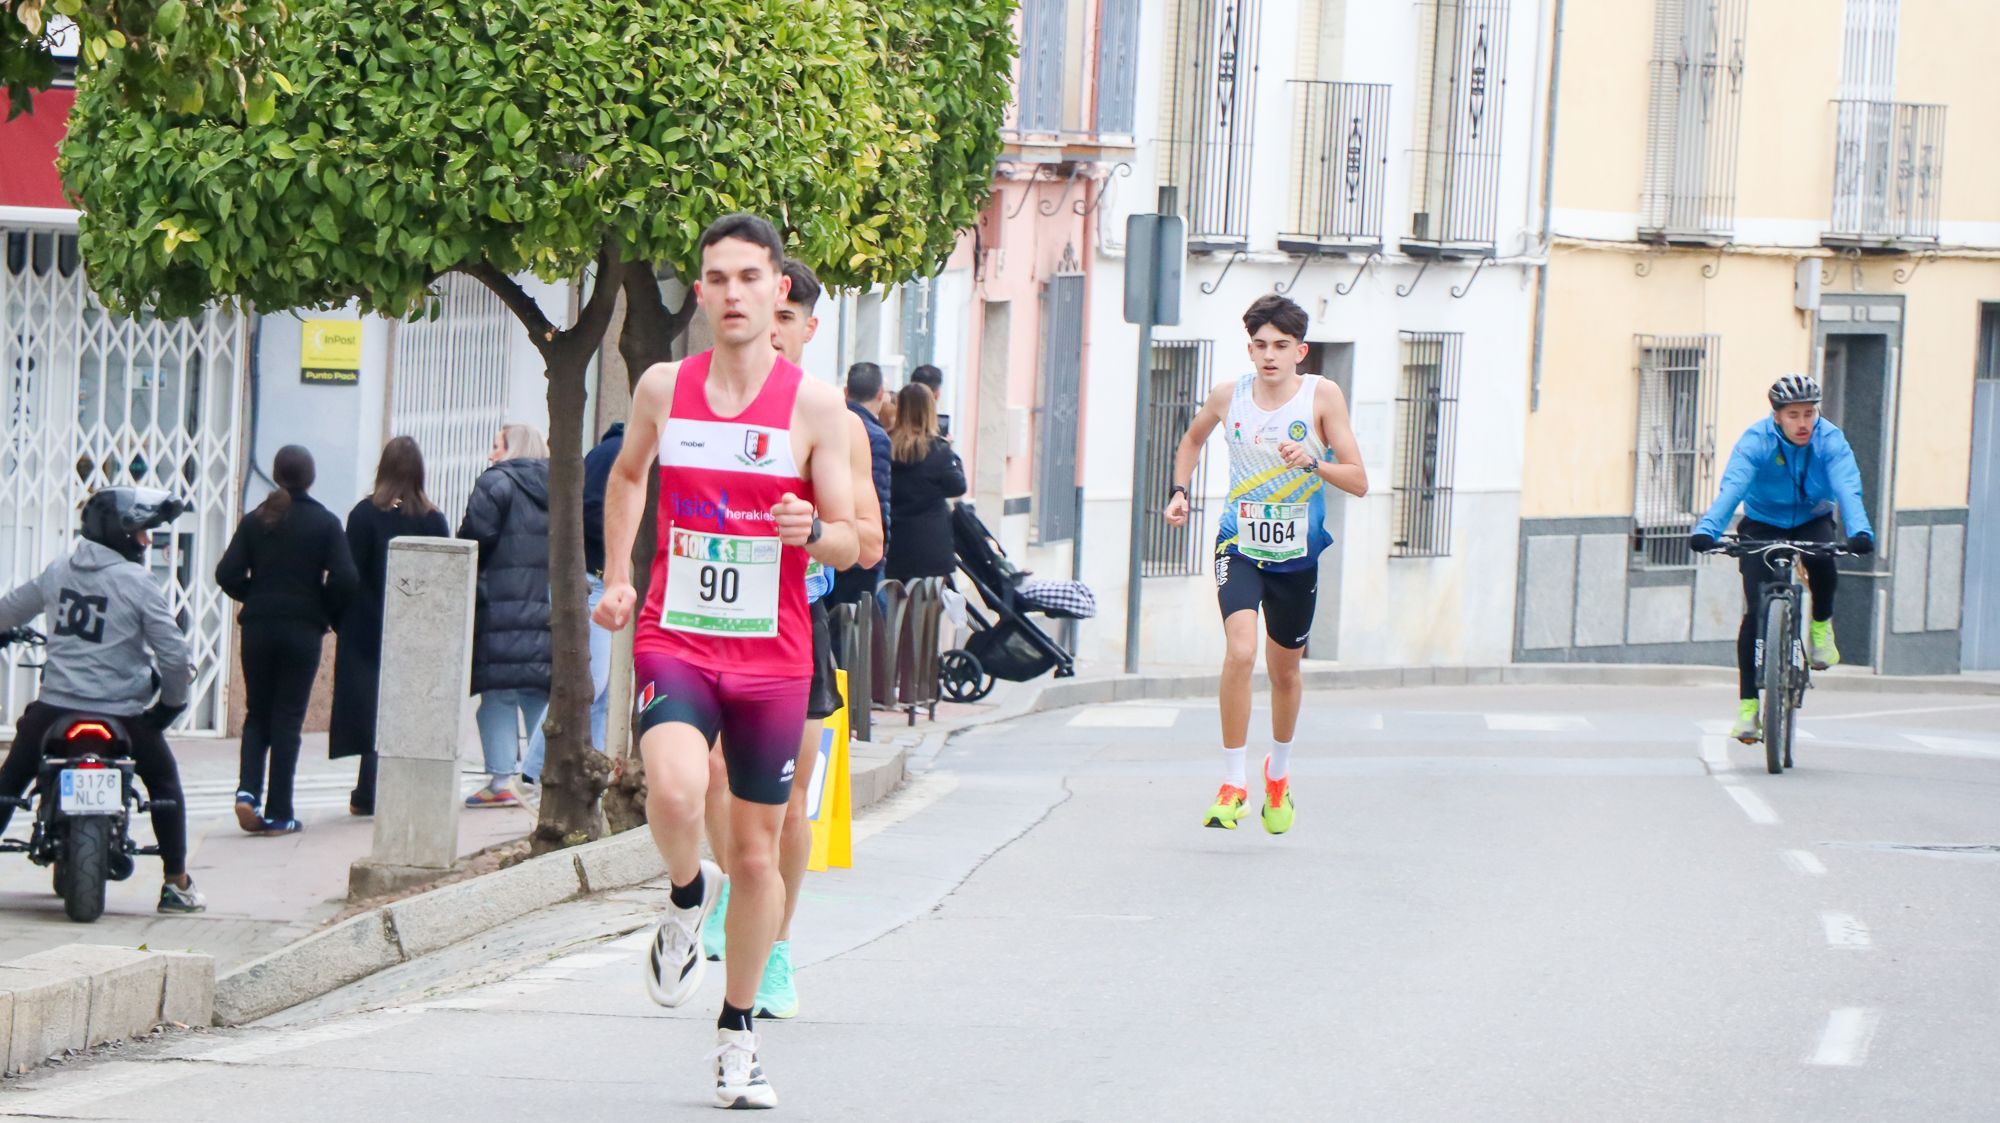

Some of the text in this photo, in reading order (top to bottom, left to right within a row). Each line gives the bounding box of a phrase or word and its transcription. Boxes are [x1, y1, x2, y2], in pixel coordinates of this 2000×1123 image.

[324, 335, 356, 346] InPost
[305, 371, 357, 380] Punto Pack
[680, 440, 705, 448] mobel
[1247, 521, 1296, 544] 1064
[679, 533, 712, 560] 10K
[699, 565, 740, 604] 90
[75, 774, 116, 789] 3176
[75, 790, 106, 806] NLC
